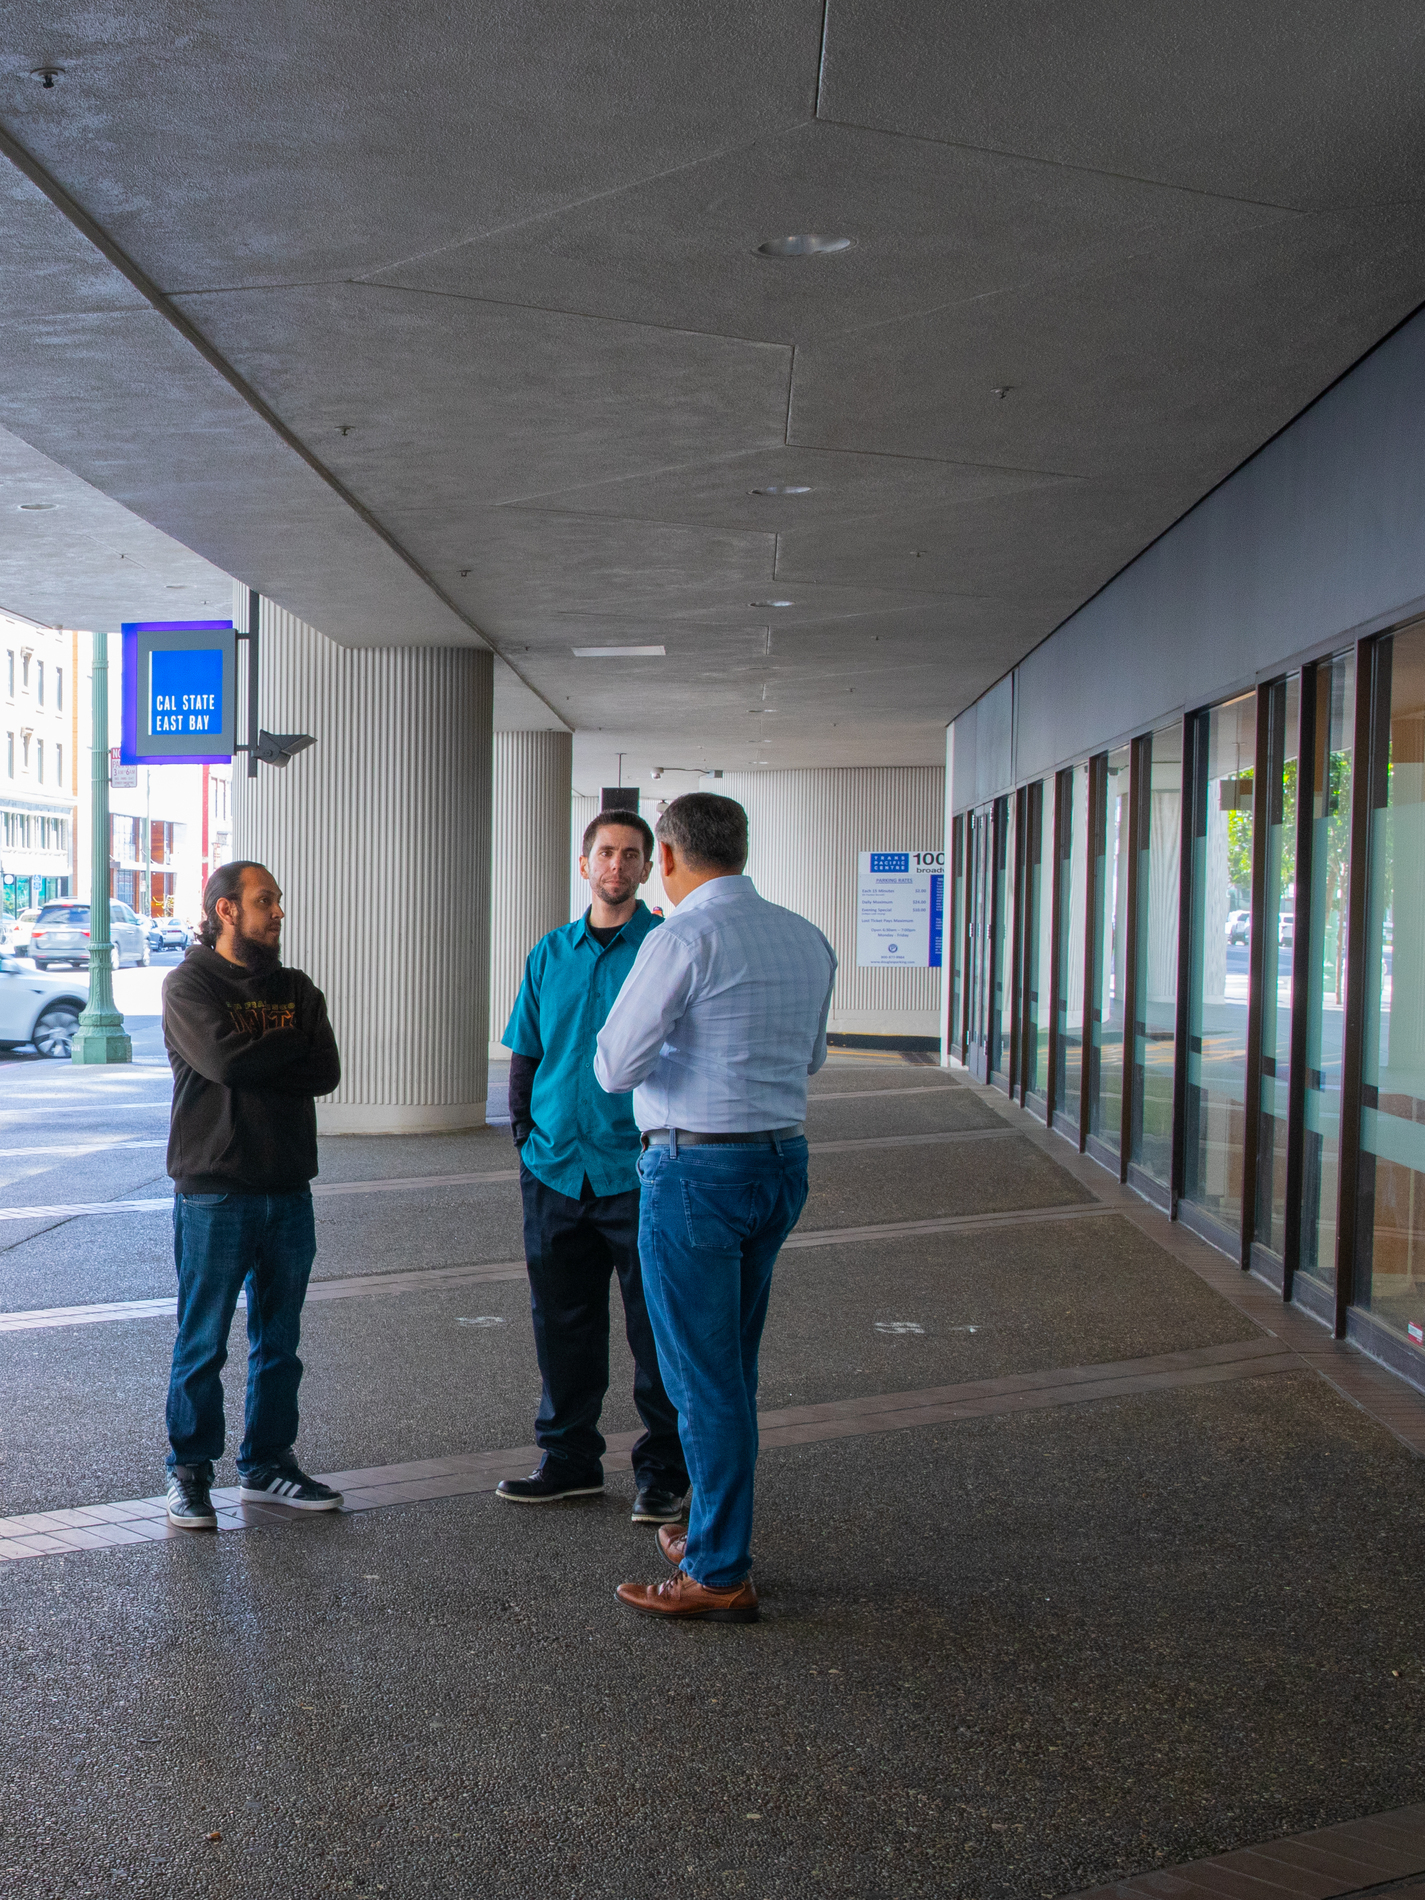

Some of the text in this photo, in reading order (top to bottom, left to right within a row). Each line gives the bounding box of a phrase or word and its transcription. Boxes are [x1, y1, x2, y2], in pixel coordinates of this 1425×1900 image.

[156, 694, 215, 711] CAL STATE
[156, 715, 210, 731] EAST BAY
